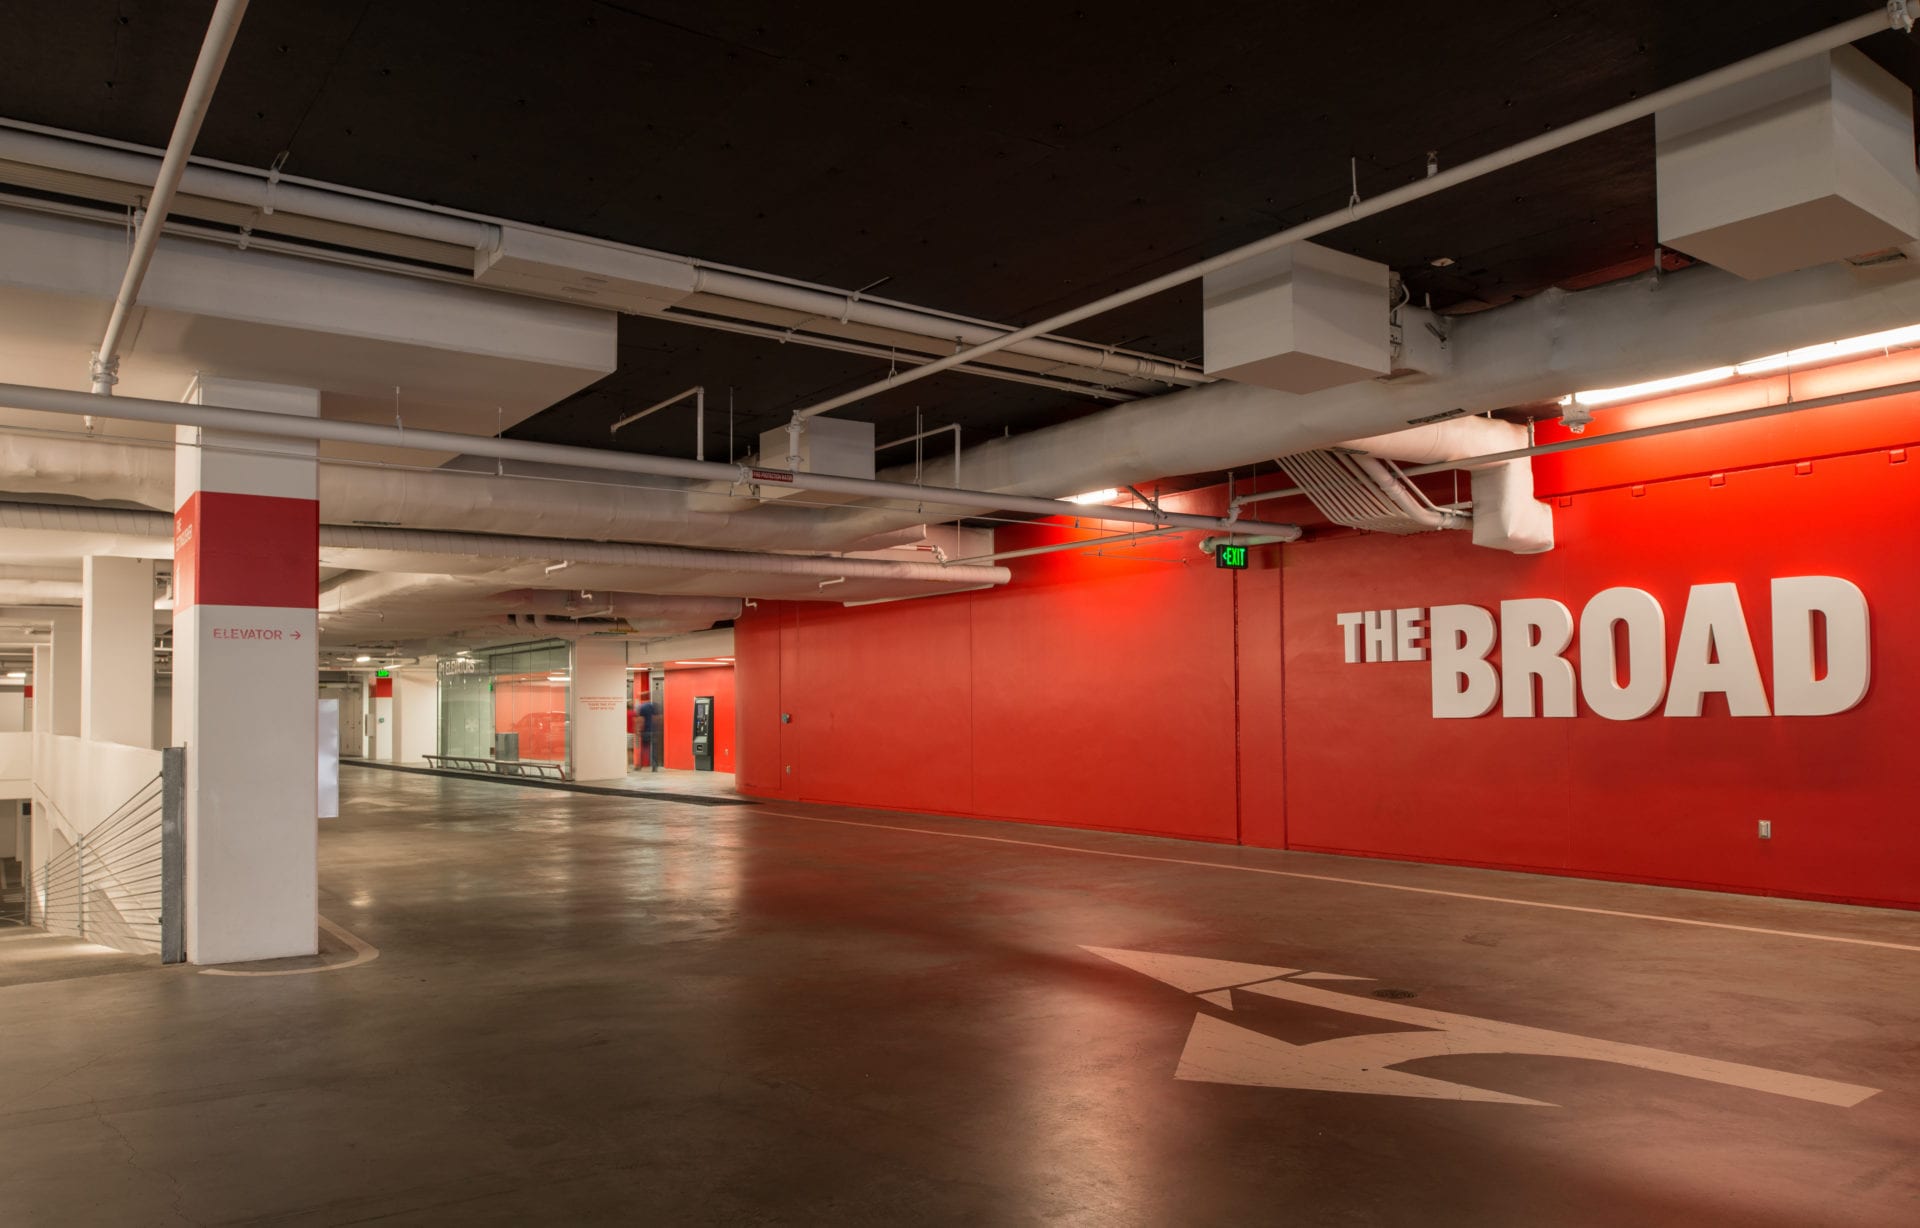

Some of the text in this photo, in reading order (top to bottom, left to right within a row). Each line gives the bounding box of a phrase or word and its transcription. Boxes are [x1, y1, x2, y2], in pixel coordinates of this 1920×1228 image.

[1226, 546, 1246, 567] EXIT
[213, 628, 283, 641] ELEVATOR
[1337, 575, 1871, 720] THE BROAD
